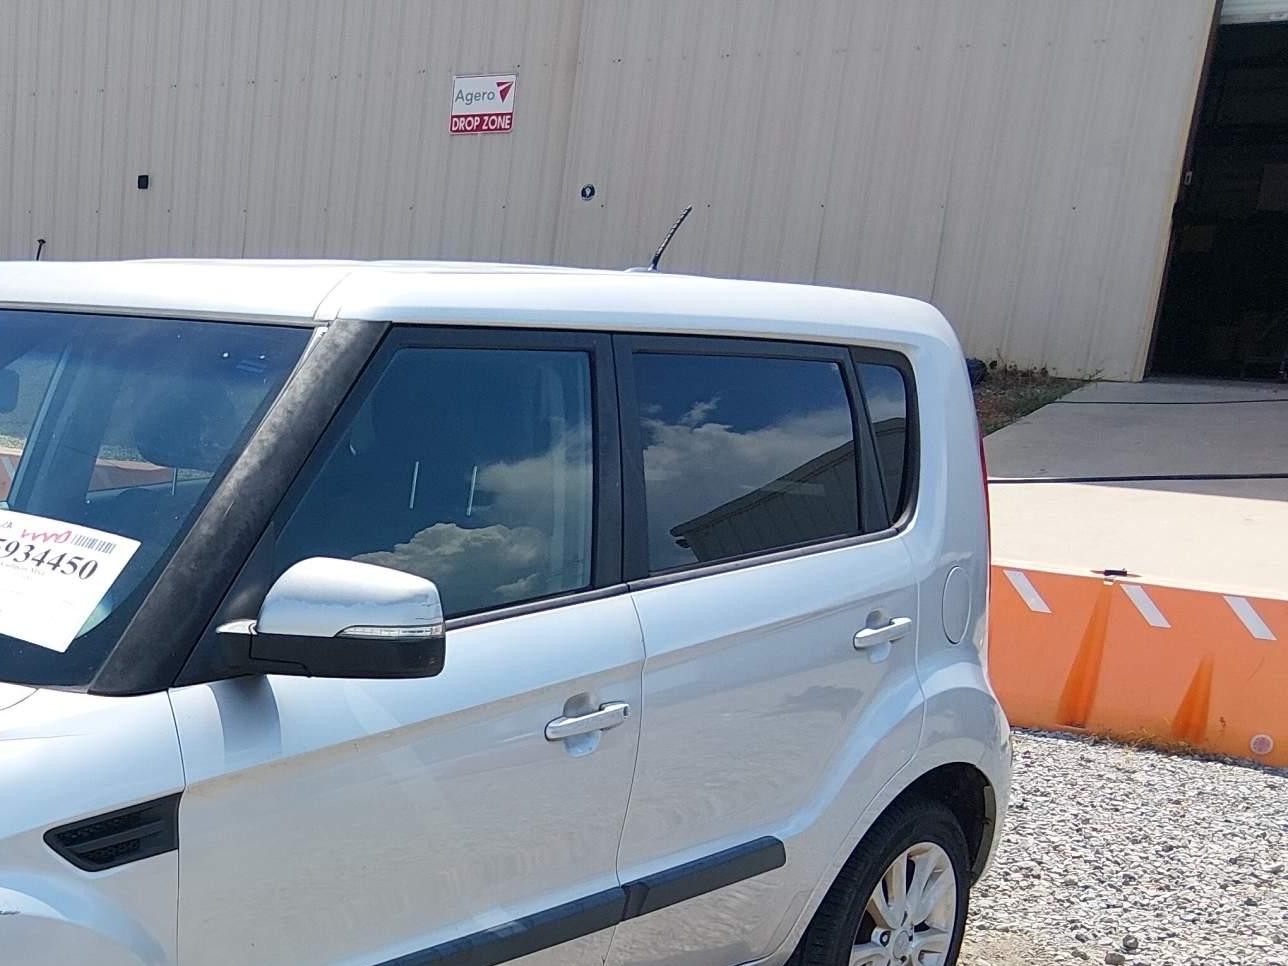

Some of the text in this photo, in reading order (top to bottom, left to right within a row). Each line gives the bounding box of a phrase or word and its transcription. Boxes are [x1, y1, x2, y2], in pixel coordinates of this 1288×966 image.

[455, 89, 495, 106] Agero
[451, 115, 512, 131] DROP ZONE
